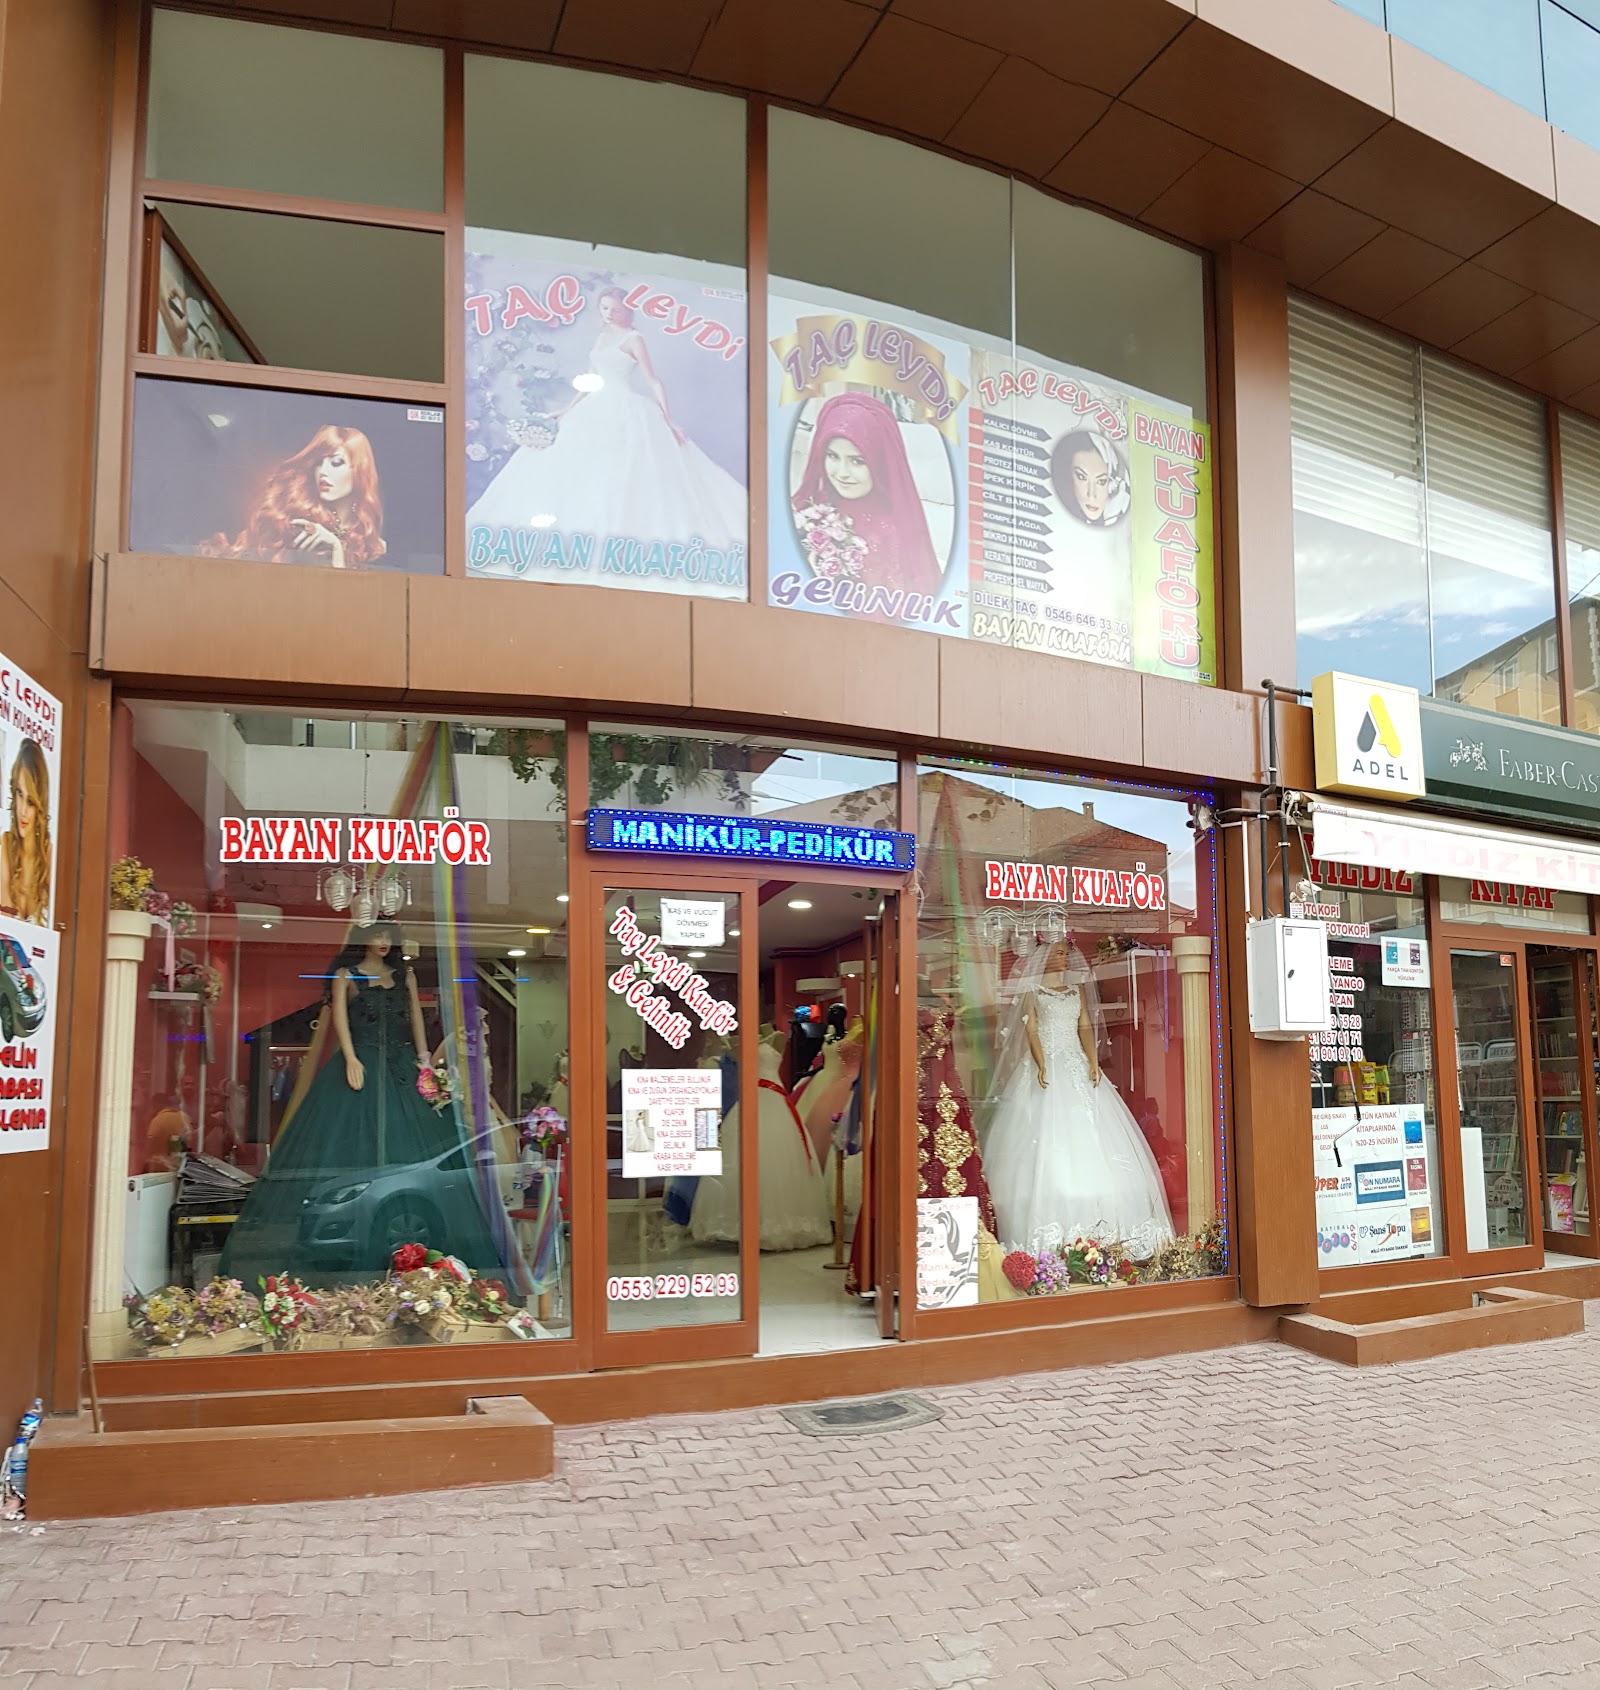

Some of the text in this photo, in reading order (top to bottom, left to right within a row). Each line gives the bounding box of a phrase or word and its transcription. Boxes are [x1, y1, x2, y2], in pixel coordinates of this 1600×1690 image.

[1135, 413, 1205, 462] BAYAN
[1013, 599, 1038, 618] TAÇ
[1045, 605, 1072, 623] 0546
[1076, 612, 1097, 627] 646
[1100, 617, 1112, 630] 33
[1115, 620, 1128, 635] 76
[1353, 758, 1409, 781] ADEL
[1500, 748, 1600, 794] FABER-CAS
[221, 806, 491, 865] BAYAN KUAFÖR
[985, 860, 1166, 910] BAYAN KUAFÖR
[1303, 902, 1340, 918] TOKOPİ
[609, 906, 738, 1036] Taç Leydi Kuaför
[608, 964, 692, 1049] & Gelinlik
[1350, 1016, 1362, 1030] 28
[1320, 1031, 1337, 1045] 857
[1350, 1032, 1362, 1046] 71
[0, 1042, 37, 1069] ELİN
[1321, 1047, 1338, 1061] 901
[1351, 1048, 1364, 1062] 10
[1354, 1111, 1373, 1121] BTÜN
[1374, 1111, 1397, 1120] KAYNAK
[1374, 1176, 1401, 1185] NUMARA
[1369, 1224, 1406, 1238] Şans Topu
[607, 1273, 739, 1300] 0553 229 52 93
